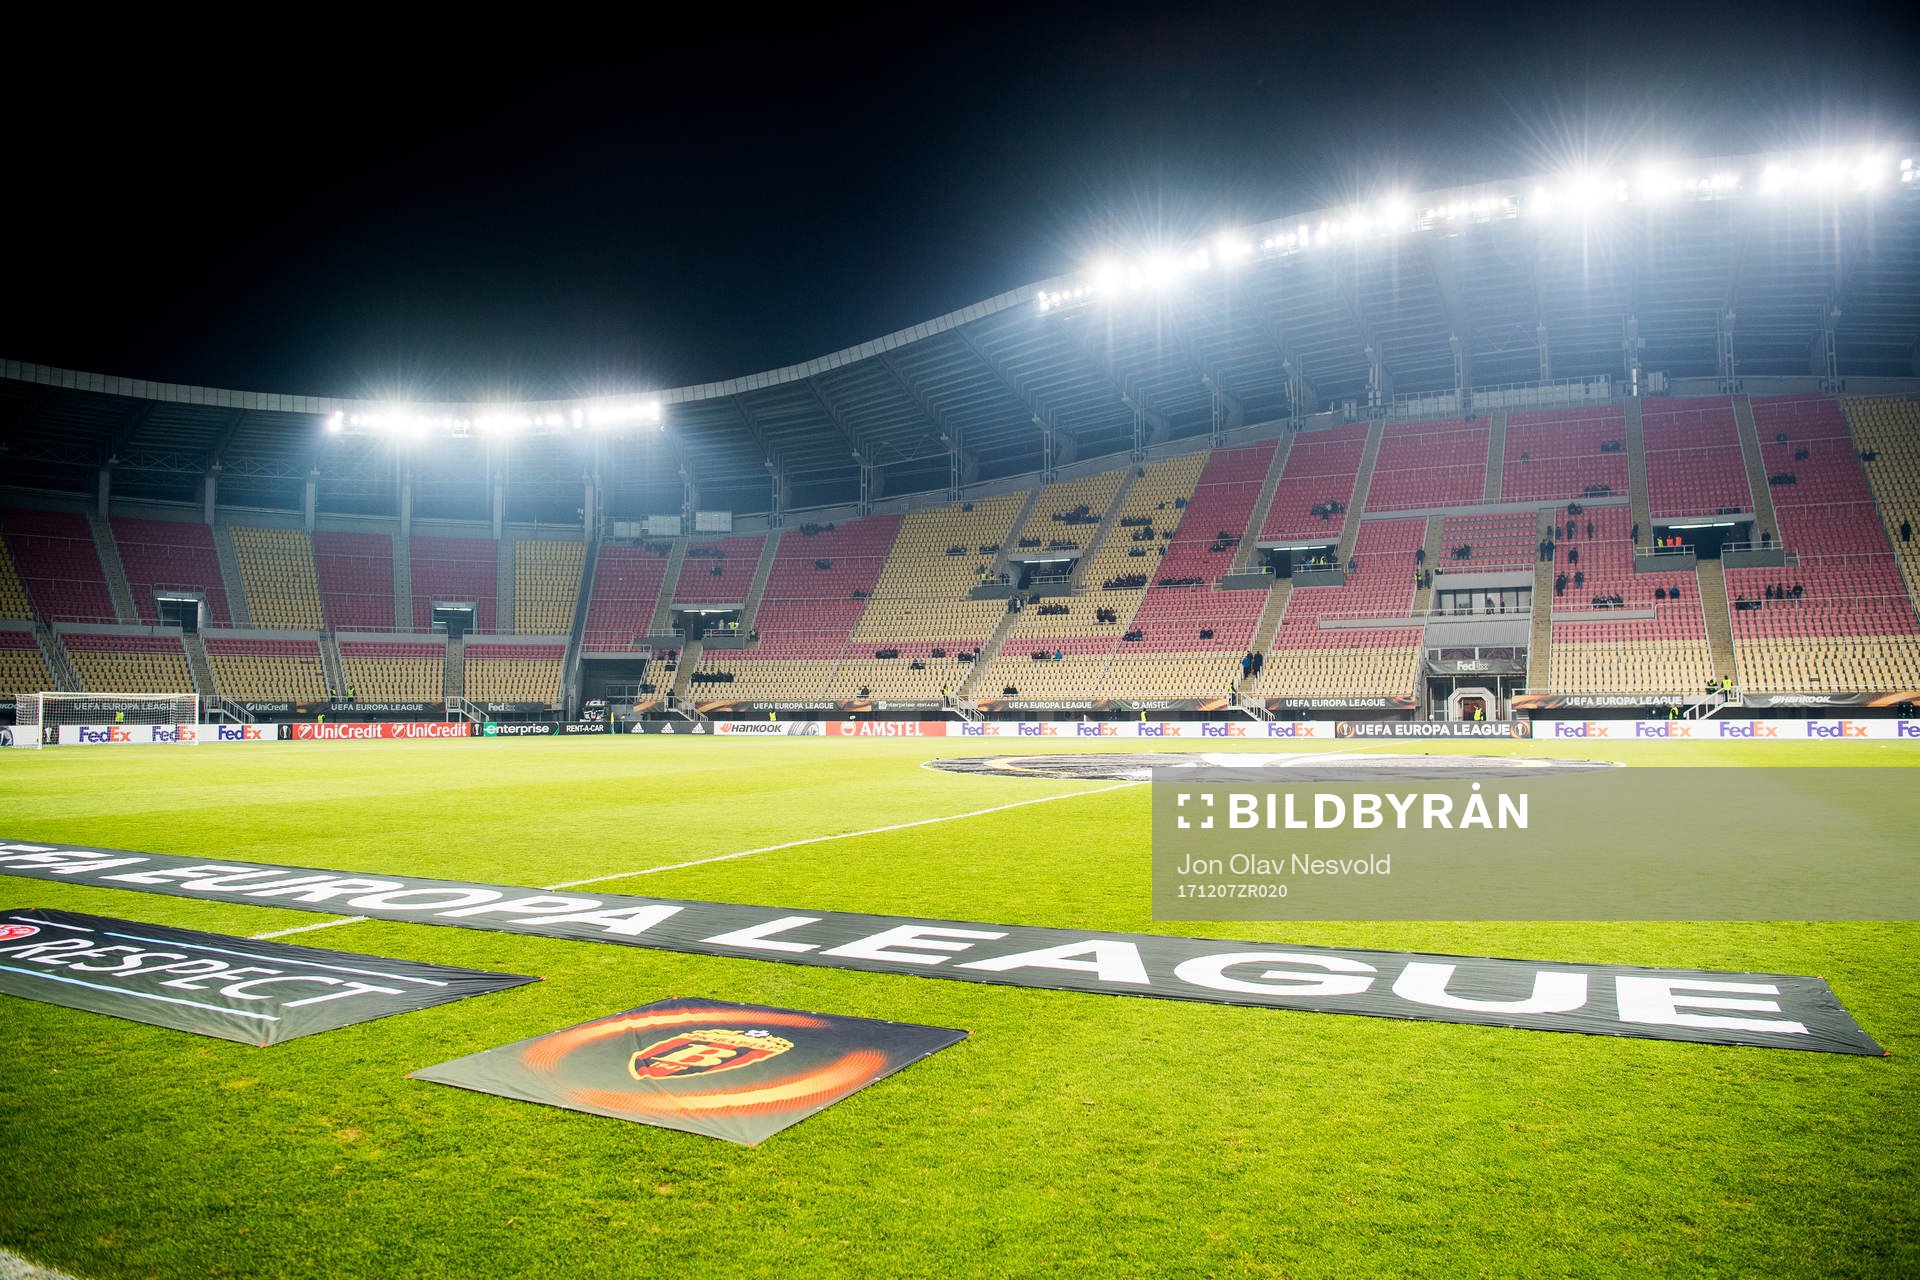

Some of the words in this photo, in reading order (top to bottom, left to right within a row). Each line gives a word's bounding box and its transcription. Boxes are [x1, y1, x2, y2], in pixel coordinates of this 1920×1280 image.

[1457, 660, 1488, 671] FedEx
[256, 703, 288, 711] UniCredit
[488, 702, 515, 711] FedEx
[753, 702, 773, 710] UEFA
[775, 702, 804, 710] EUROPA
[805, 702, 834, 710] LEAGUE
[1286, 699, 1309, 708] UEFA
[1311, 699, 1346, 708] EUROPA
[1349, 699, 1385, 708] LEAGUE
[1566, 696, 1593, 706] UEFA
[1596, 696, 1636, 706] EUROPA
[1639, 696, 1682, 706] LEAGUE
[80, 726, 130, 742] FedEx
[152, 726, 195, 742] FedEx
[219, 725, 261, 740] FedEx
[314, 723, 382, 739] UniCredit
[406, 722, 467, 737] UniCredit
[485, 722, 549, 735] enterprise
[566, 724, 604, 733] RENT-A-CAR
[860, 721, 923, 736] AMSTEL
[962, 723, 999, 736] FedEx
[1018, 723, 1057, 736] FedEx
[1077, 723, 1117, 736] FedEx
[1138, 723, 1181, 736] FedEx
[1202, 723, 1246, 736] FedEx
[1268, 722, 1314, 736] FedEx
[1355, 723, 1392, 736] UEFA
[1395, 723, 1450, 736] EUROPA
[1454, 723, 1510, 736] LEAGUE
[1555, 721, 1608, 737] FedEx
[1636, 721, 1692, 737] FedEx
[1720, 721, 1778, 737] FedEx
[1807, 721, 1868, 737] FedEx
[98, 864, 685, 936] EUROPA
[699, 916, 1809, 1036] LEAGUE
[0, 938, 405, 1008] RESPECT
